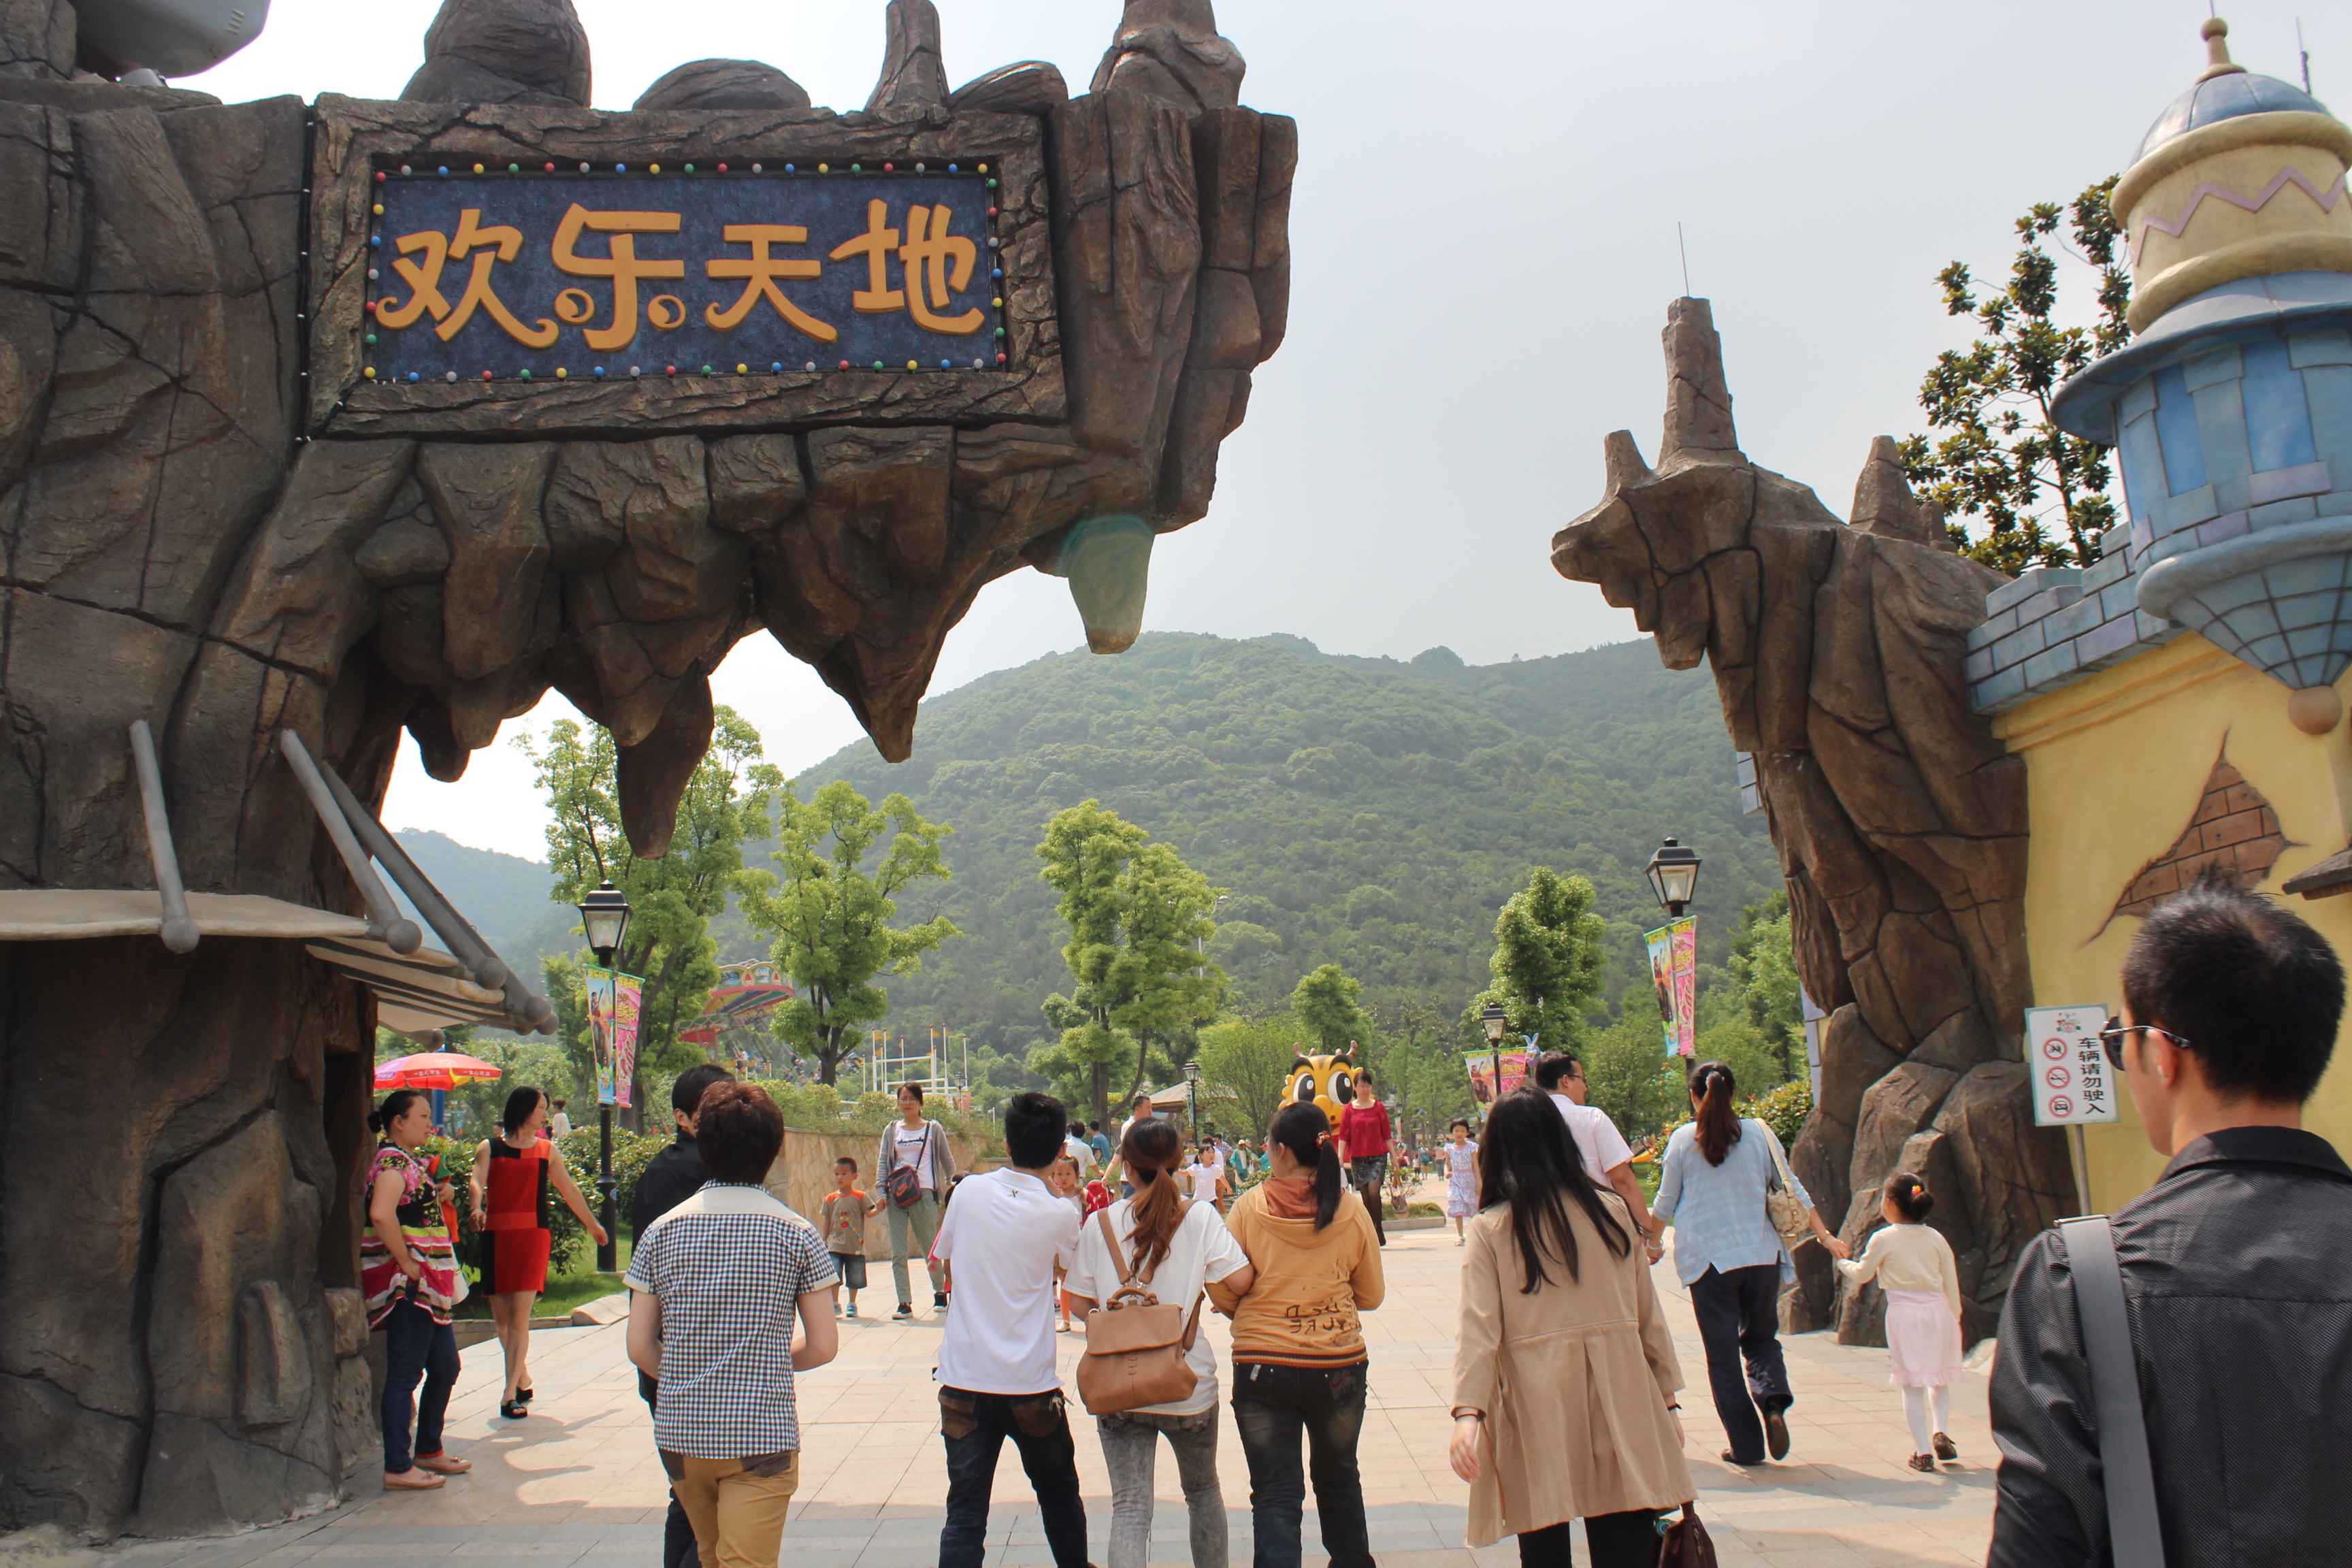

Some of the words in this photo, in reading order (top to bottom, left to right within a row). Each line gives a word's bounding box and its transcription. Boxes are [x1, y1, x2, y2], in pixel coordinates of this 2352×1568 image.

[375, 198, 985, 351] 欢乐天地
[2077, 1036, 2106, 1115] 车辆请勿驶入
